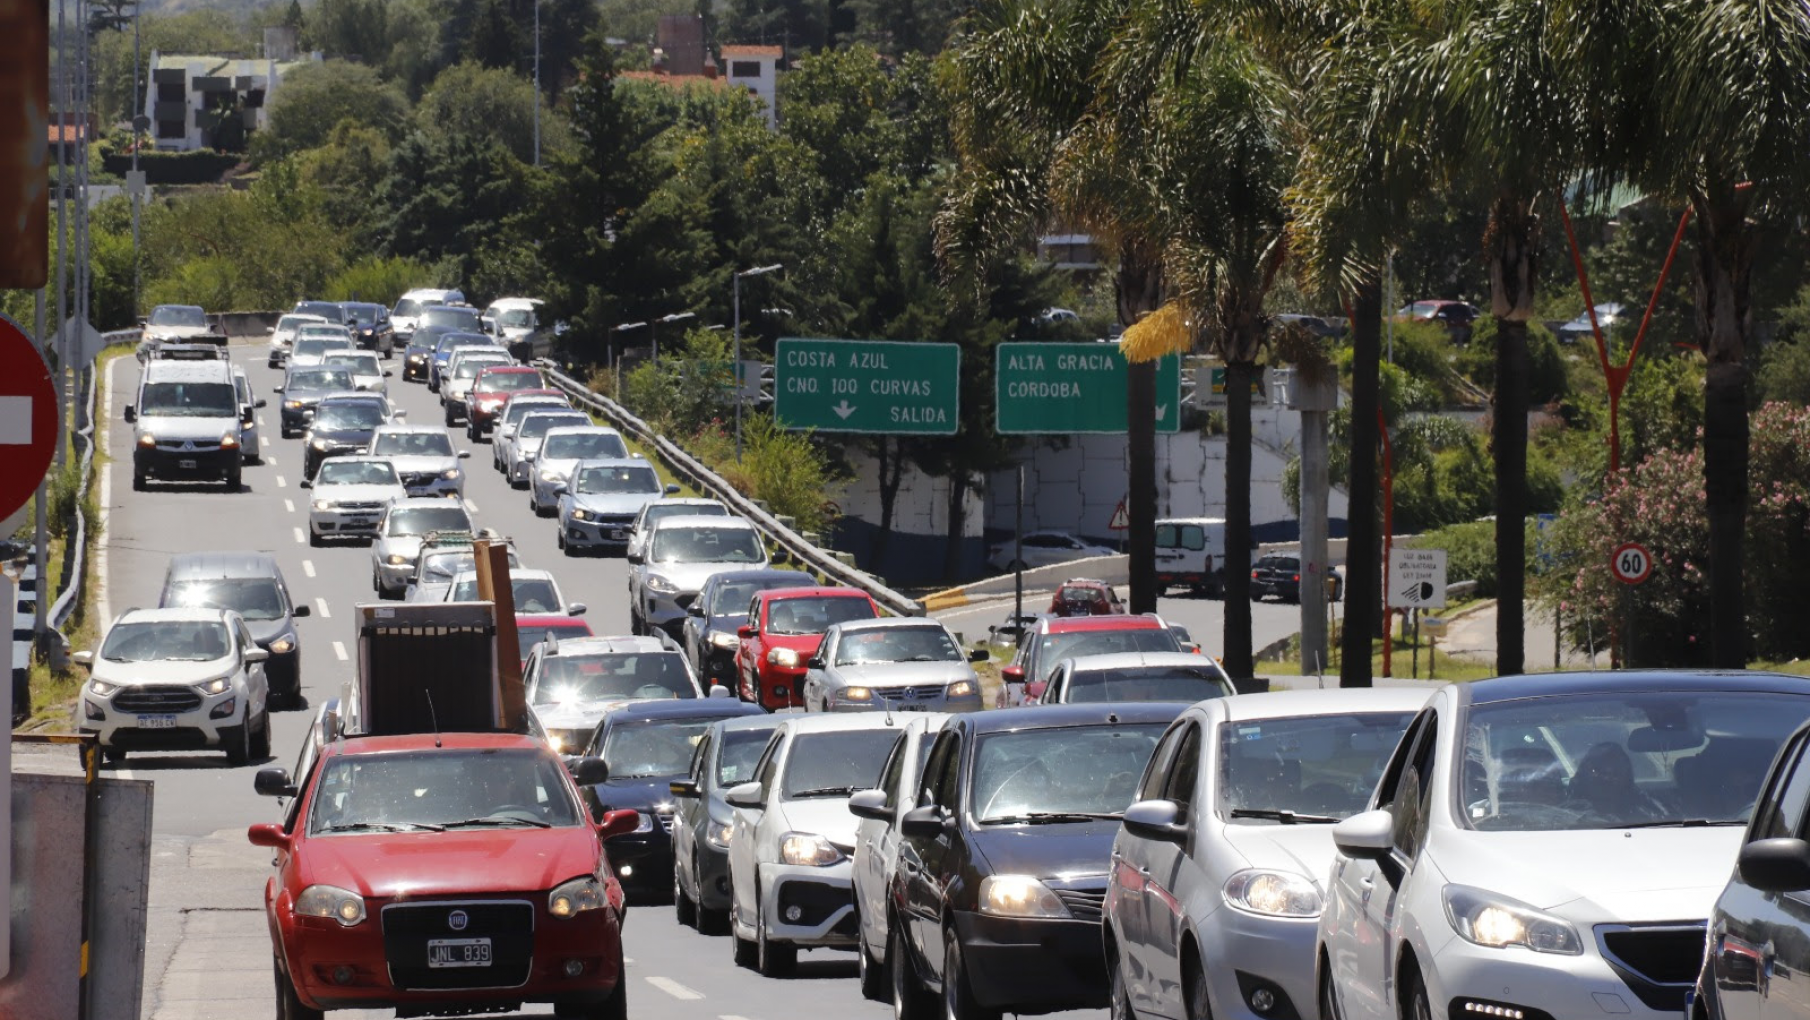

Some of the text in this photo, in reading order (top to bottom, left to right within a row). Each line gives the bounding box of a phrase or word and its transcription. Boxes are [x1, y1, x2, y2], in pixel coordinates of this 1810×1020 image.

[787, 350, 889, 369] COSTA AZUL
[1008, 354, 1114, 370] ALTA GRACIA
[786, 376, 931, 397] CNO. 100 CURVAS
[890, 406, 947, 423] SALIDA
[1621, 553, 1642, 574] 60
[430, 945, 490, 963] JNL 839
